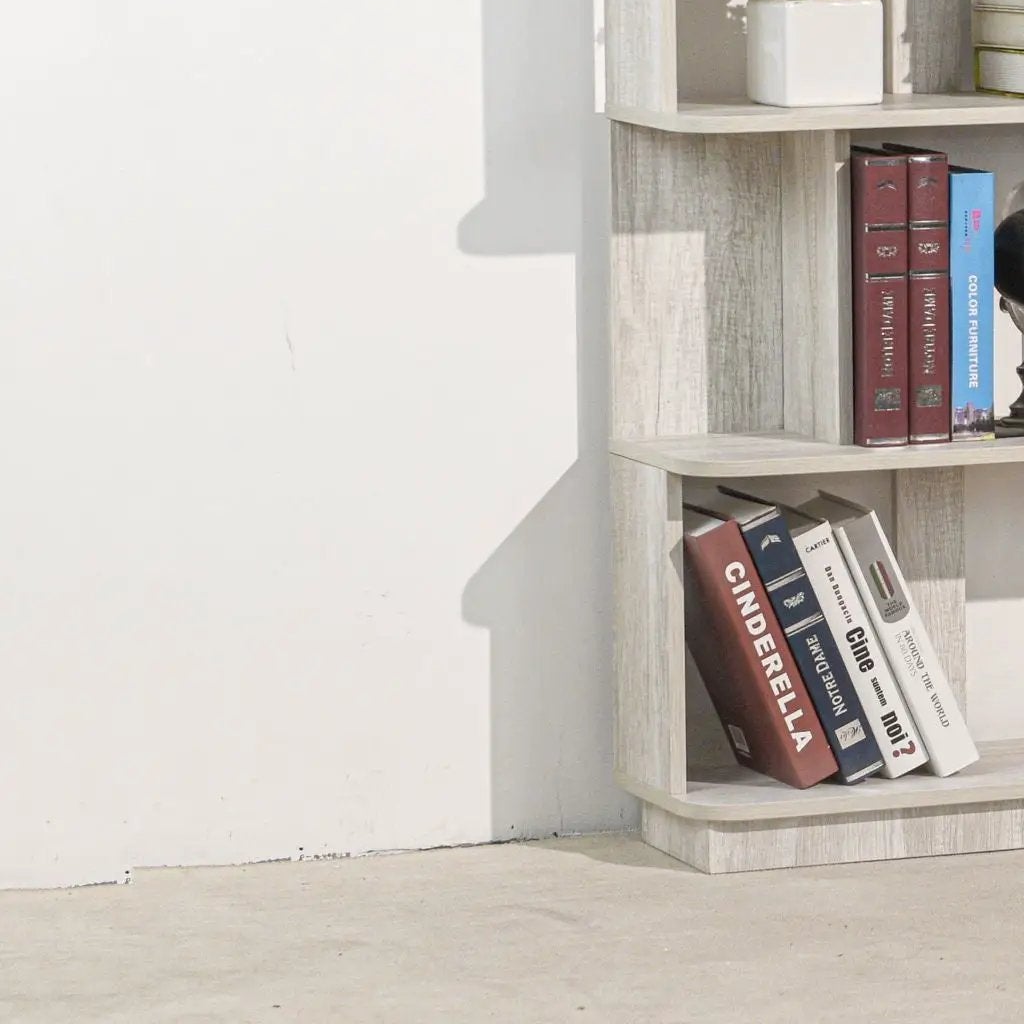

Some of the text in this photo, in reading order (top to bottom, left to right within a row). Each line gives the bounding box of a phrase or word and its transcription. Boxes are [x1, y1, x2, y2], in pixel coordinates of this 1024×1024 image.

[968, 275, 979, 388] COLOR FURNITURE
[805, 537, 830, 553] CARTIER
[724, 561, 813, 753] CINDERELLA
[806, 633, 848, 717] NOTRE DAME
[845, 626, 916, 758] Cine suntem noi?
[902, 629, 950, 728] AROUND THE WORLD
